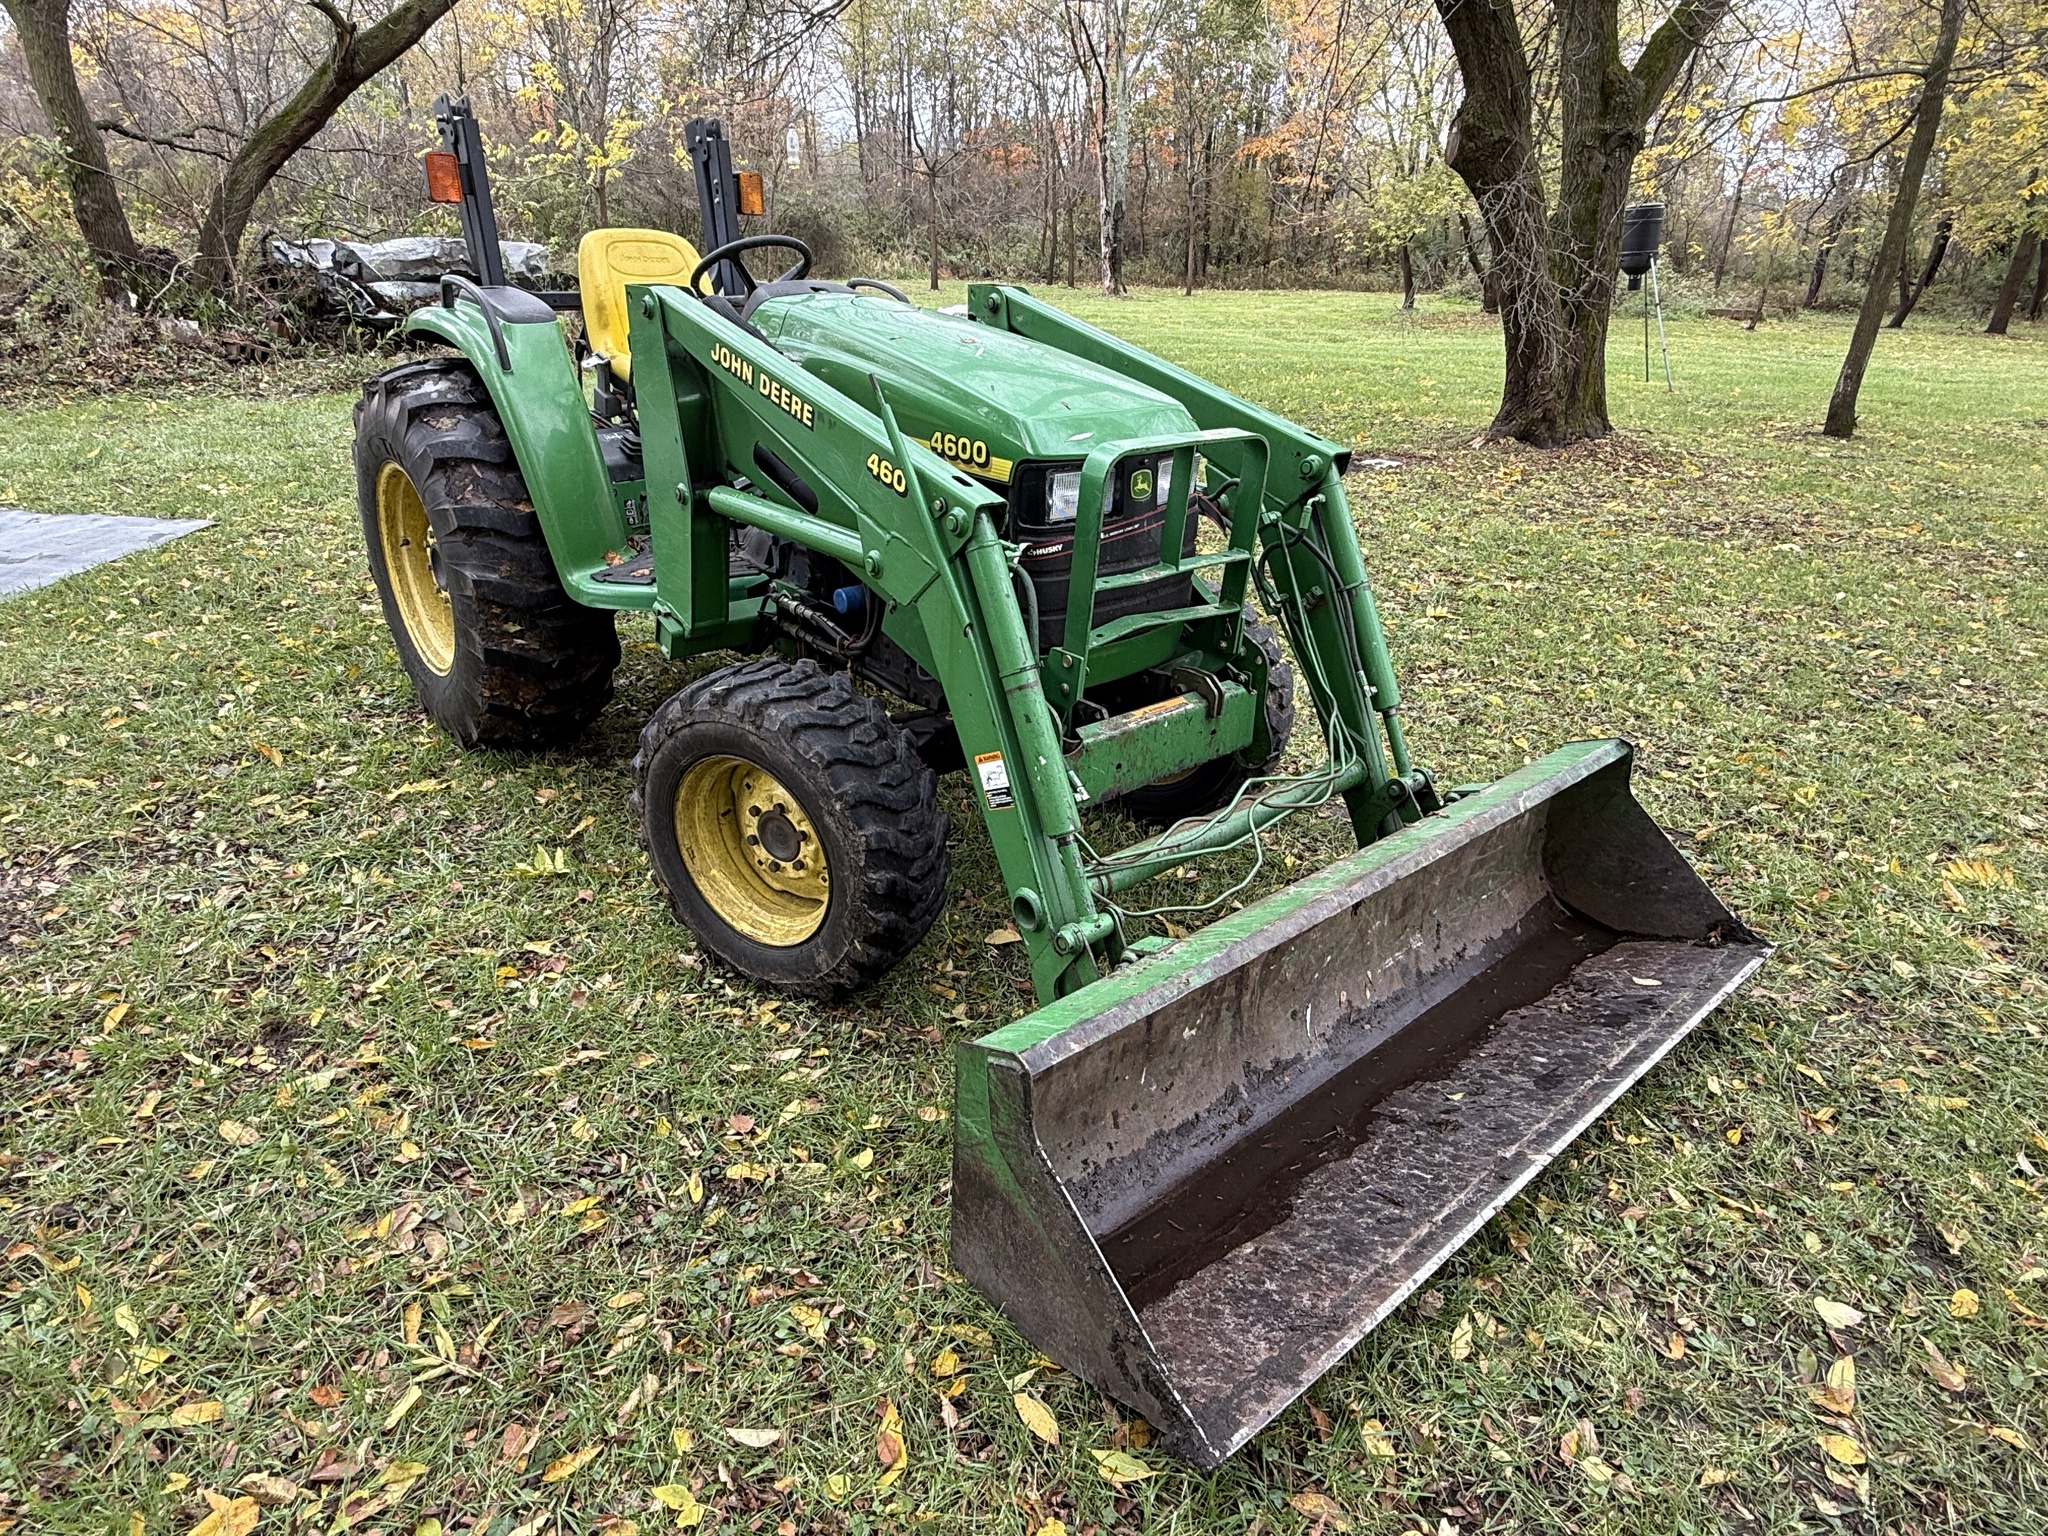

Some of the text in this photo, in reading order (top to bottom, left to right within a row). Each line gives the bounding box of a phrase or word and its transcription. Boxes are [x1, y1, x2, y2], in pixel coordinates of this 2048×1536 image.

[710, 342, 814, 429] JOHN DEERE
[929, 430, 989, 466] 4600
[866, 452, 907, 494] 460
[1036, 544, 1063, 556] HUSKY
